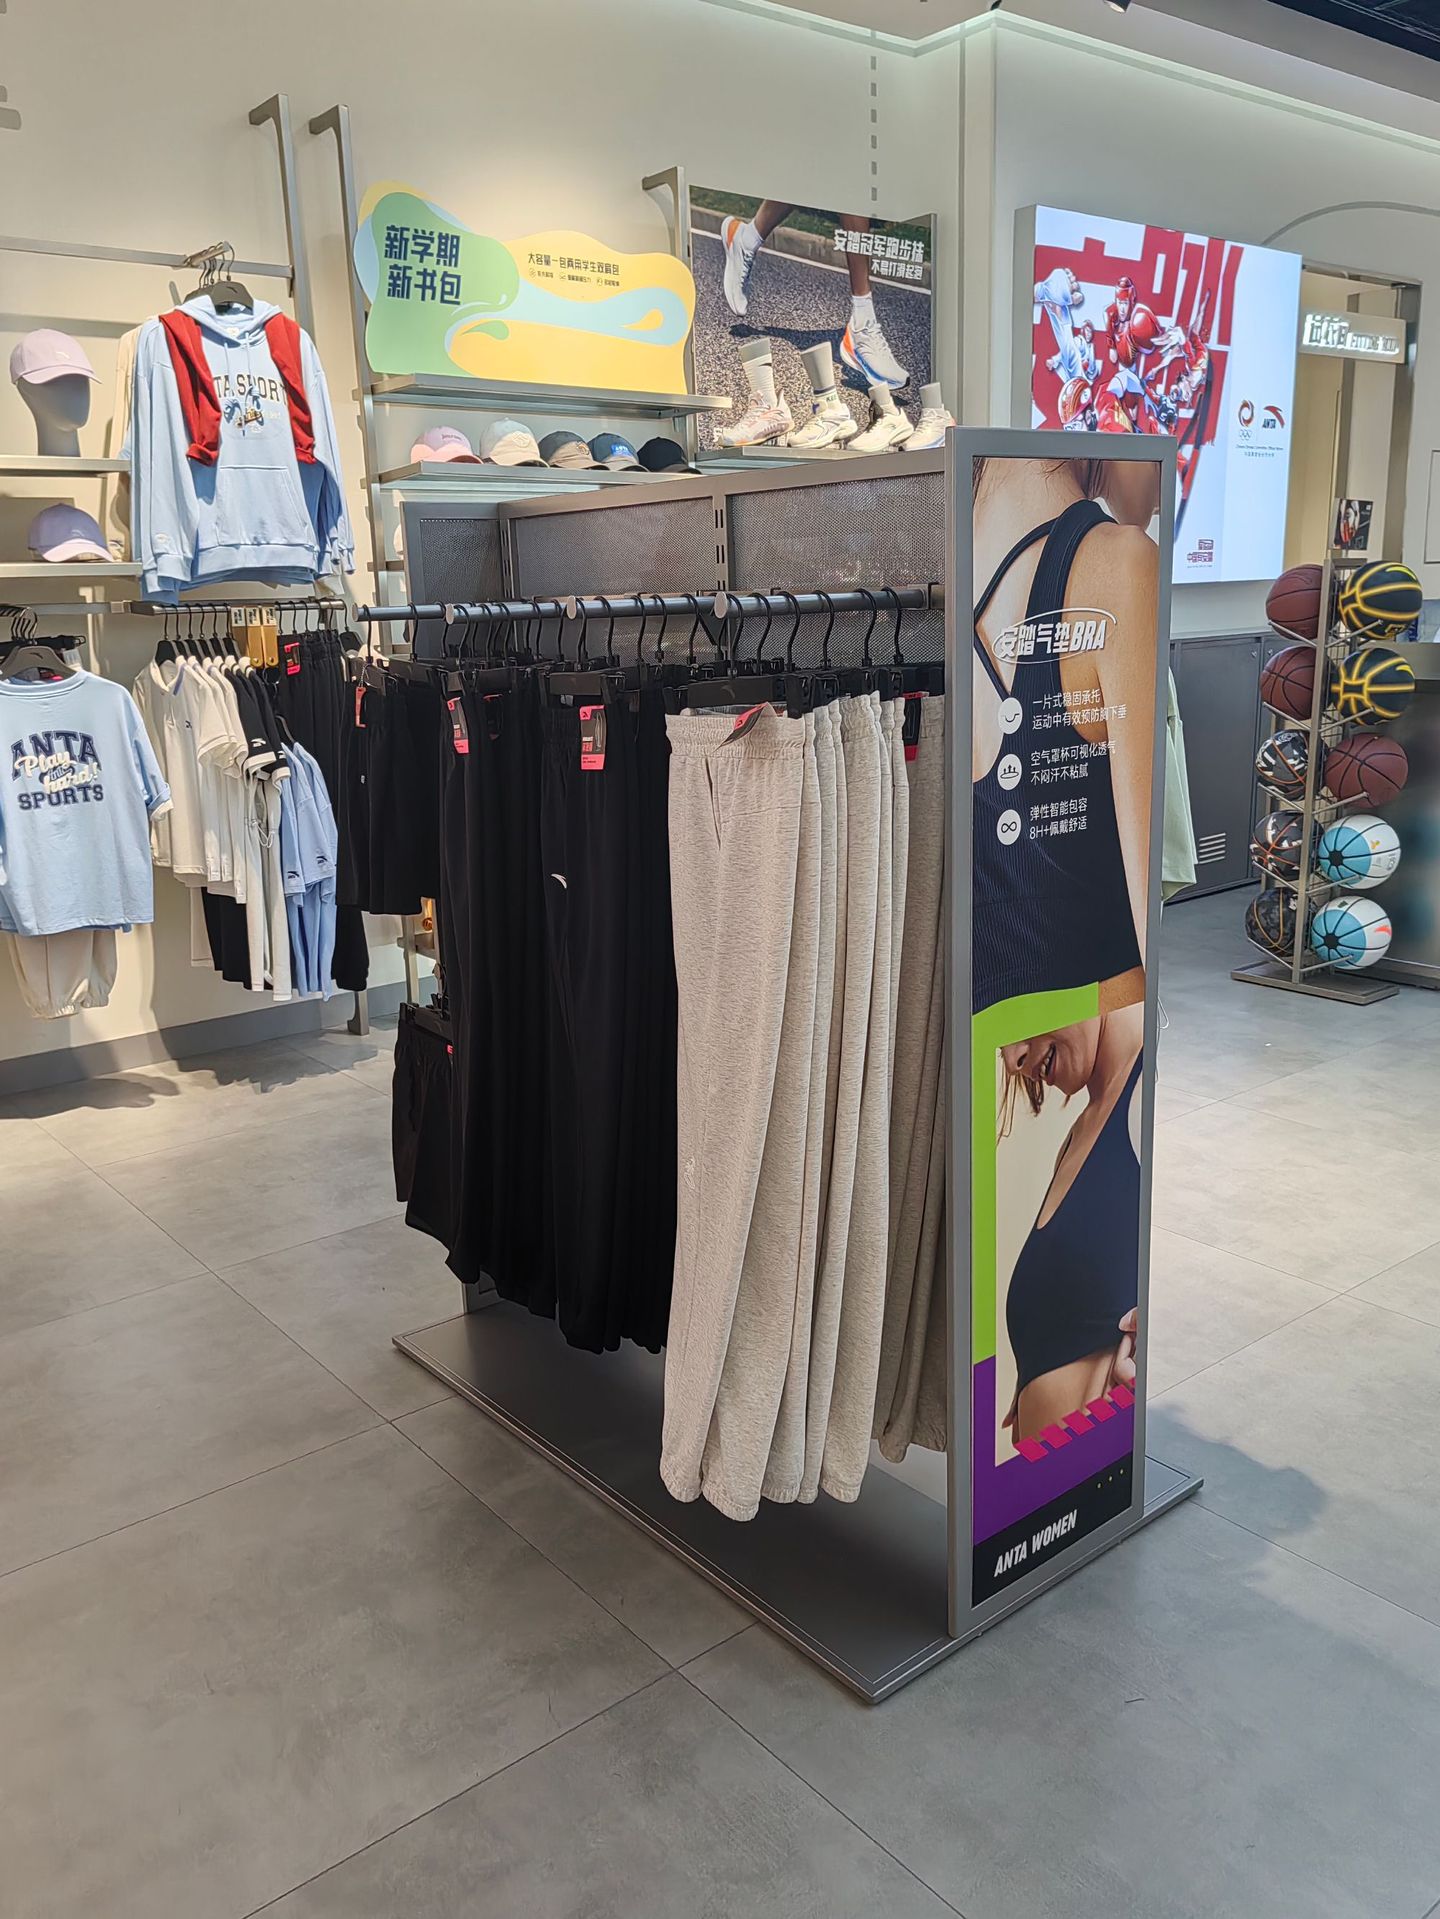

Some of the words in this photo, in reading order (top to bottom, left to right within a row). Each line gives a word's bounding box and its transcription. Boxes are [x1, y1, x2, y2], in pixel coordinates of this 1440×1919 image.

[384, 225, 460, 268] 新学期
[387, 264, 461, 306] 新书包
[1032, 688, 1101, 710] 一片式稳固承托
[1032, 704, 1127, 730] 运动中有效预防胸下垂
[11, 730, 102, 781] ANTA
[14, 751, 77, 778] Play
[1030, 740, 1116, 767] 空气罩杯可视化透气
[1030, 762, 1089, 786] 不闷汗不粘腻
[18, 784, 104, 811] SPORTS
[1030, 797, 1087, 822] 弹性智能包容
[1029, 815, 1087, 840] 8H+佩戴舒适
[994, 1540, 1027, 1577] ANTA
[1031, 1509, 1077, 1554] WOMEN
